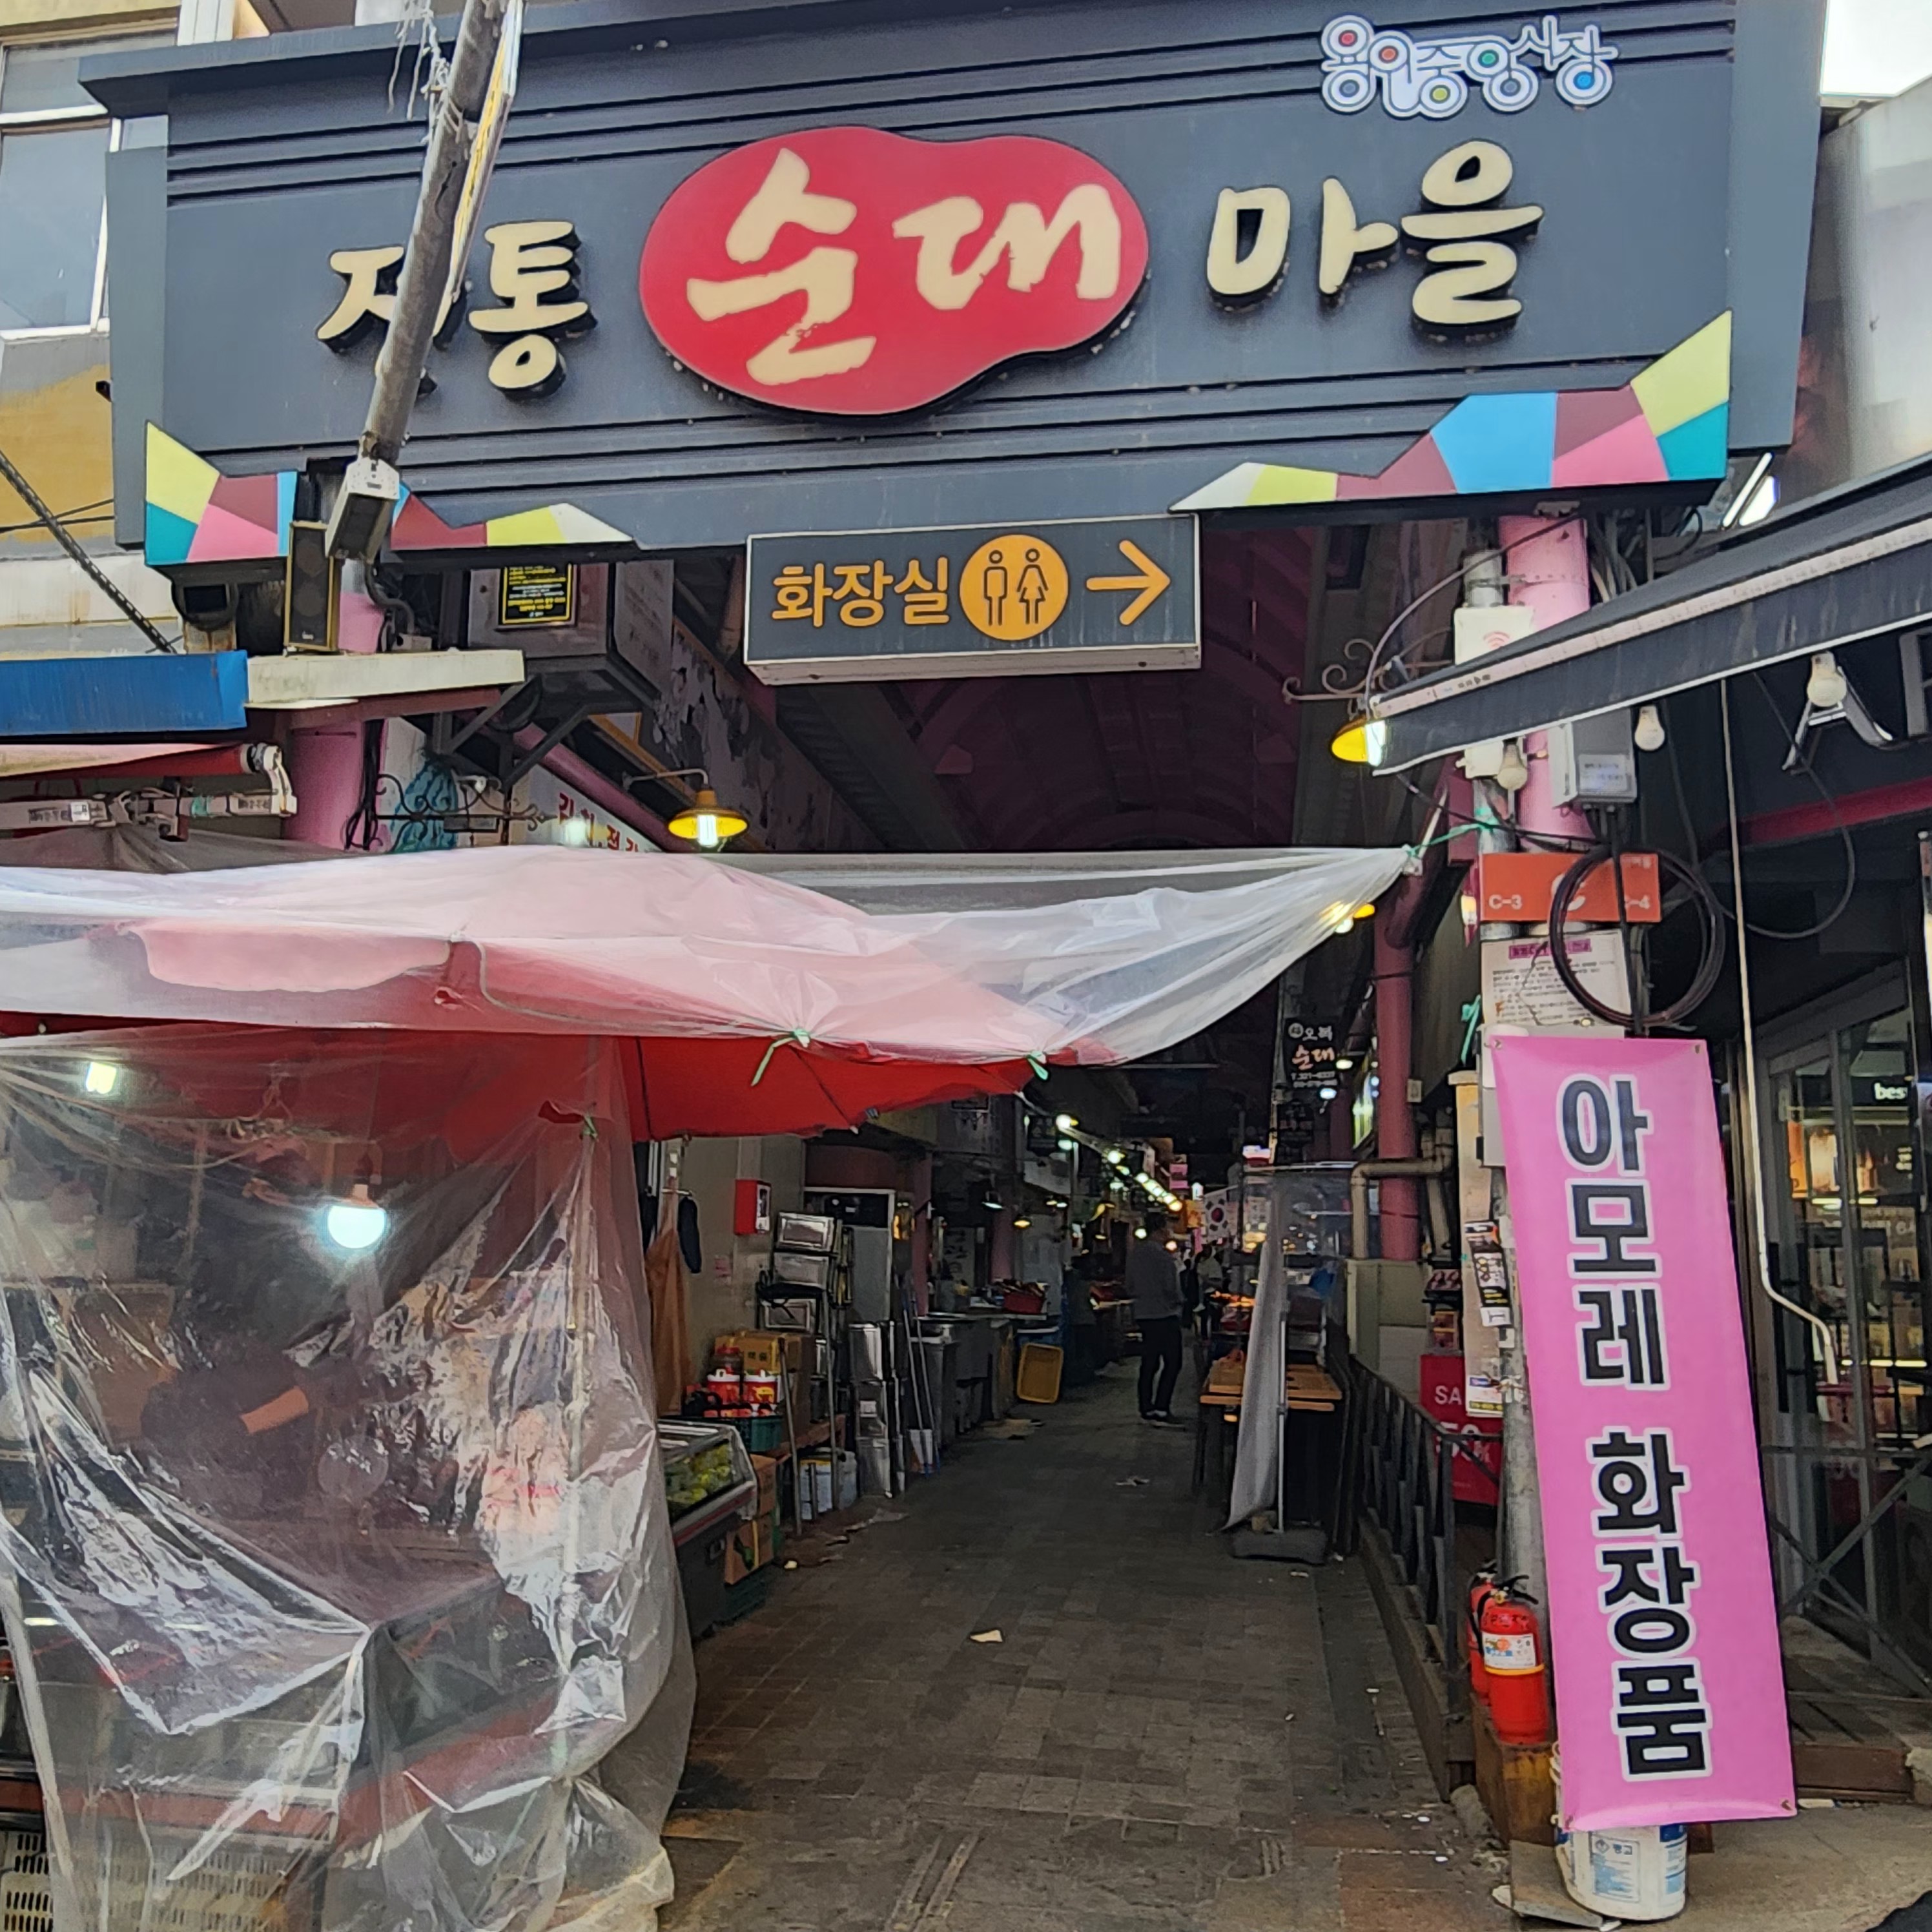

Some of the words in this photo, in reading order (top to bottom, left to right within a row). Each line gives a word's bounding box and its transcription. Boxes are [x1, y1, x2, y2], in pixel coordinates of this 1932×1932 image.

[1321, 15, 1619, 118] 용인중앙시장
[686, 147, 1121, 385] 순대
[1206, 140, 1544, 324] 마을
[772, 557, 950, 627] 화장실
[1488, 894, 1523, 910] C-3
[1559, 1076, 1668, 1387] 아모레
[1587, 1429, 1710, 1778] 화장품
